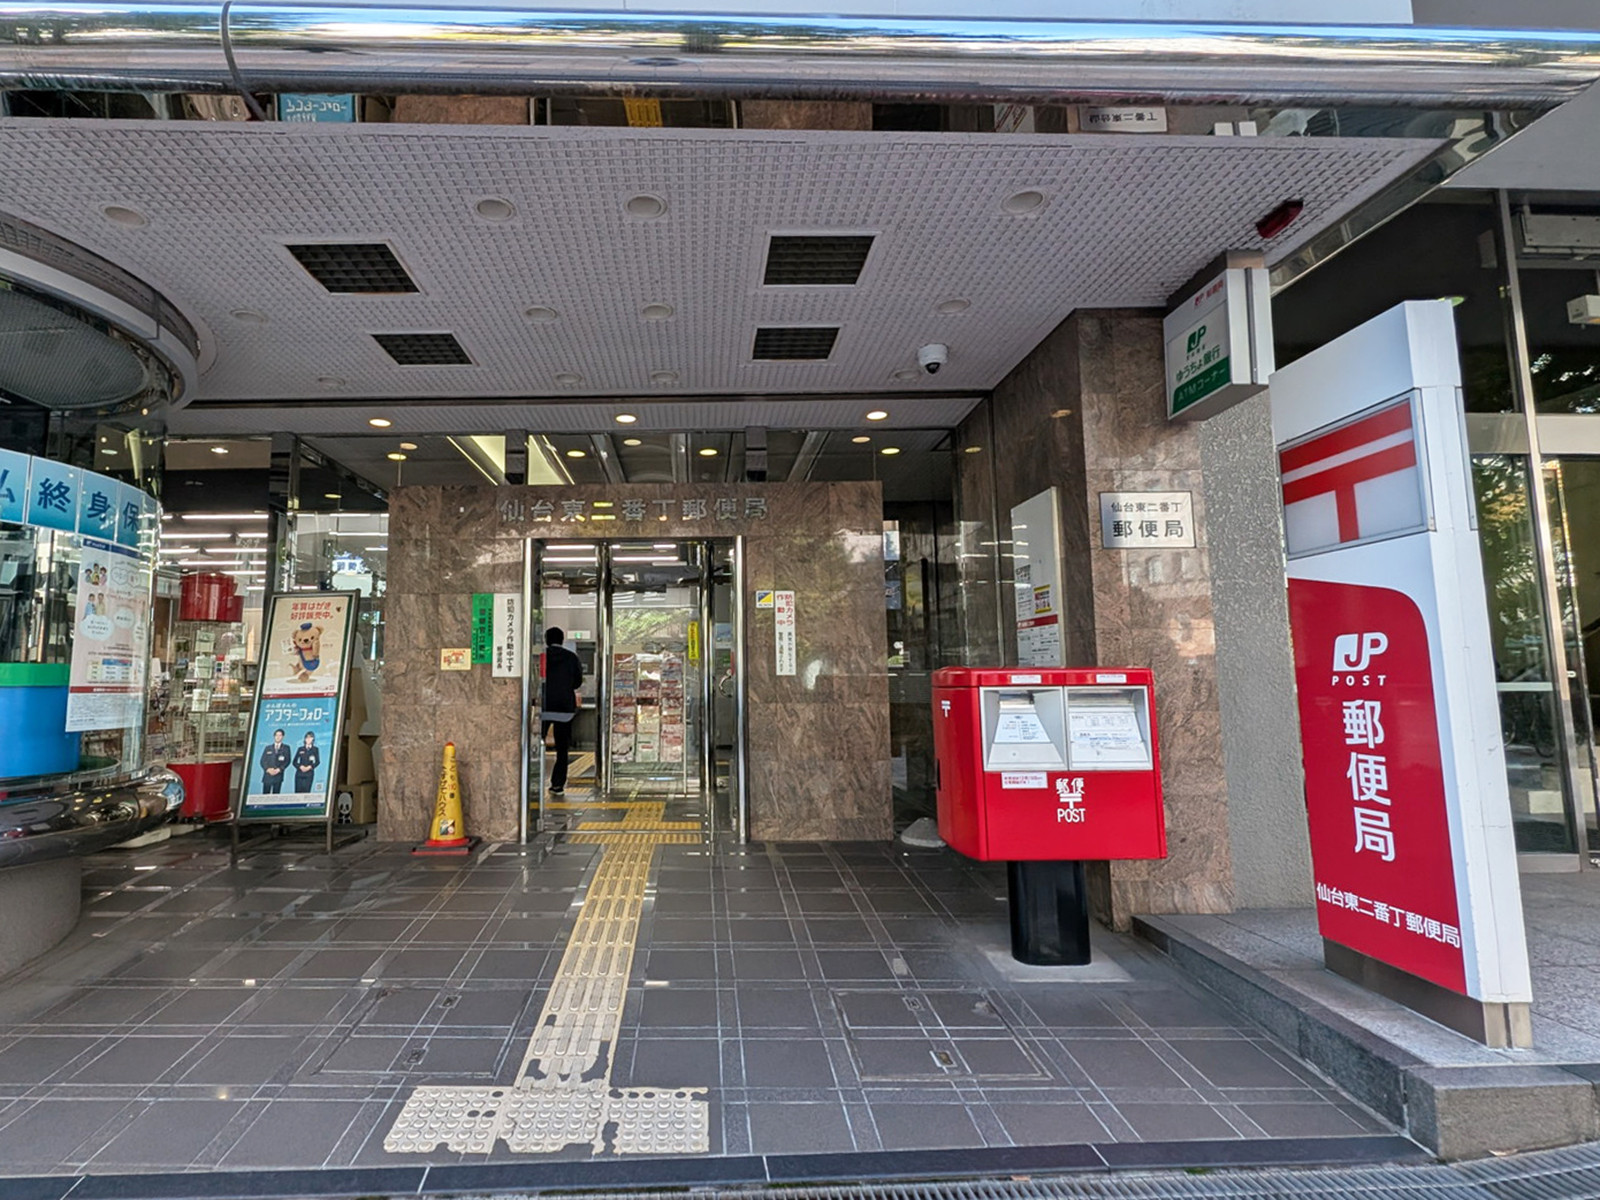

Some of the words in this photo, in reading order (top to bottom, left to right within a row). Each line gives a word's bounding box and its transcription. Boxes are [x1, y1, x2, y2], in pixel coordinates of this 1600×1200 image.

[1187, 324, 1207, 353] JP
[1176, 344, 1220, 382] ゆうちょ銀行
[500, 497, 769, 523] 仙台東二番丁郵便局
[1111, 502, 1182, 513] 仙台東二番丁
[1112, 520, 1184, 538] 郵便局
[291, 602, 332, 611] 年賀はがき
[1332, 631, 1388, 671] JP
[1331, 674, 1387, 686] POST
[265, 708, 329, 721] アフターフォロー
[1055, 778, 1085, 795] 郵便
[1341, 699, 1396, 862] 郵便局
[1057, 808, 1086, 823] POST
[1316, 882, 1461, 949] 仙台東二番丁郵便局
